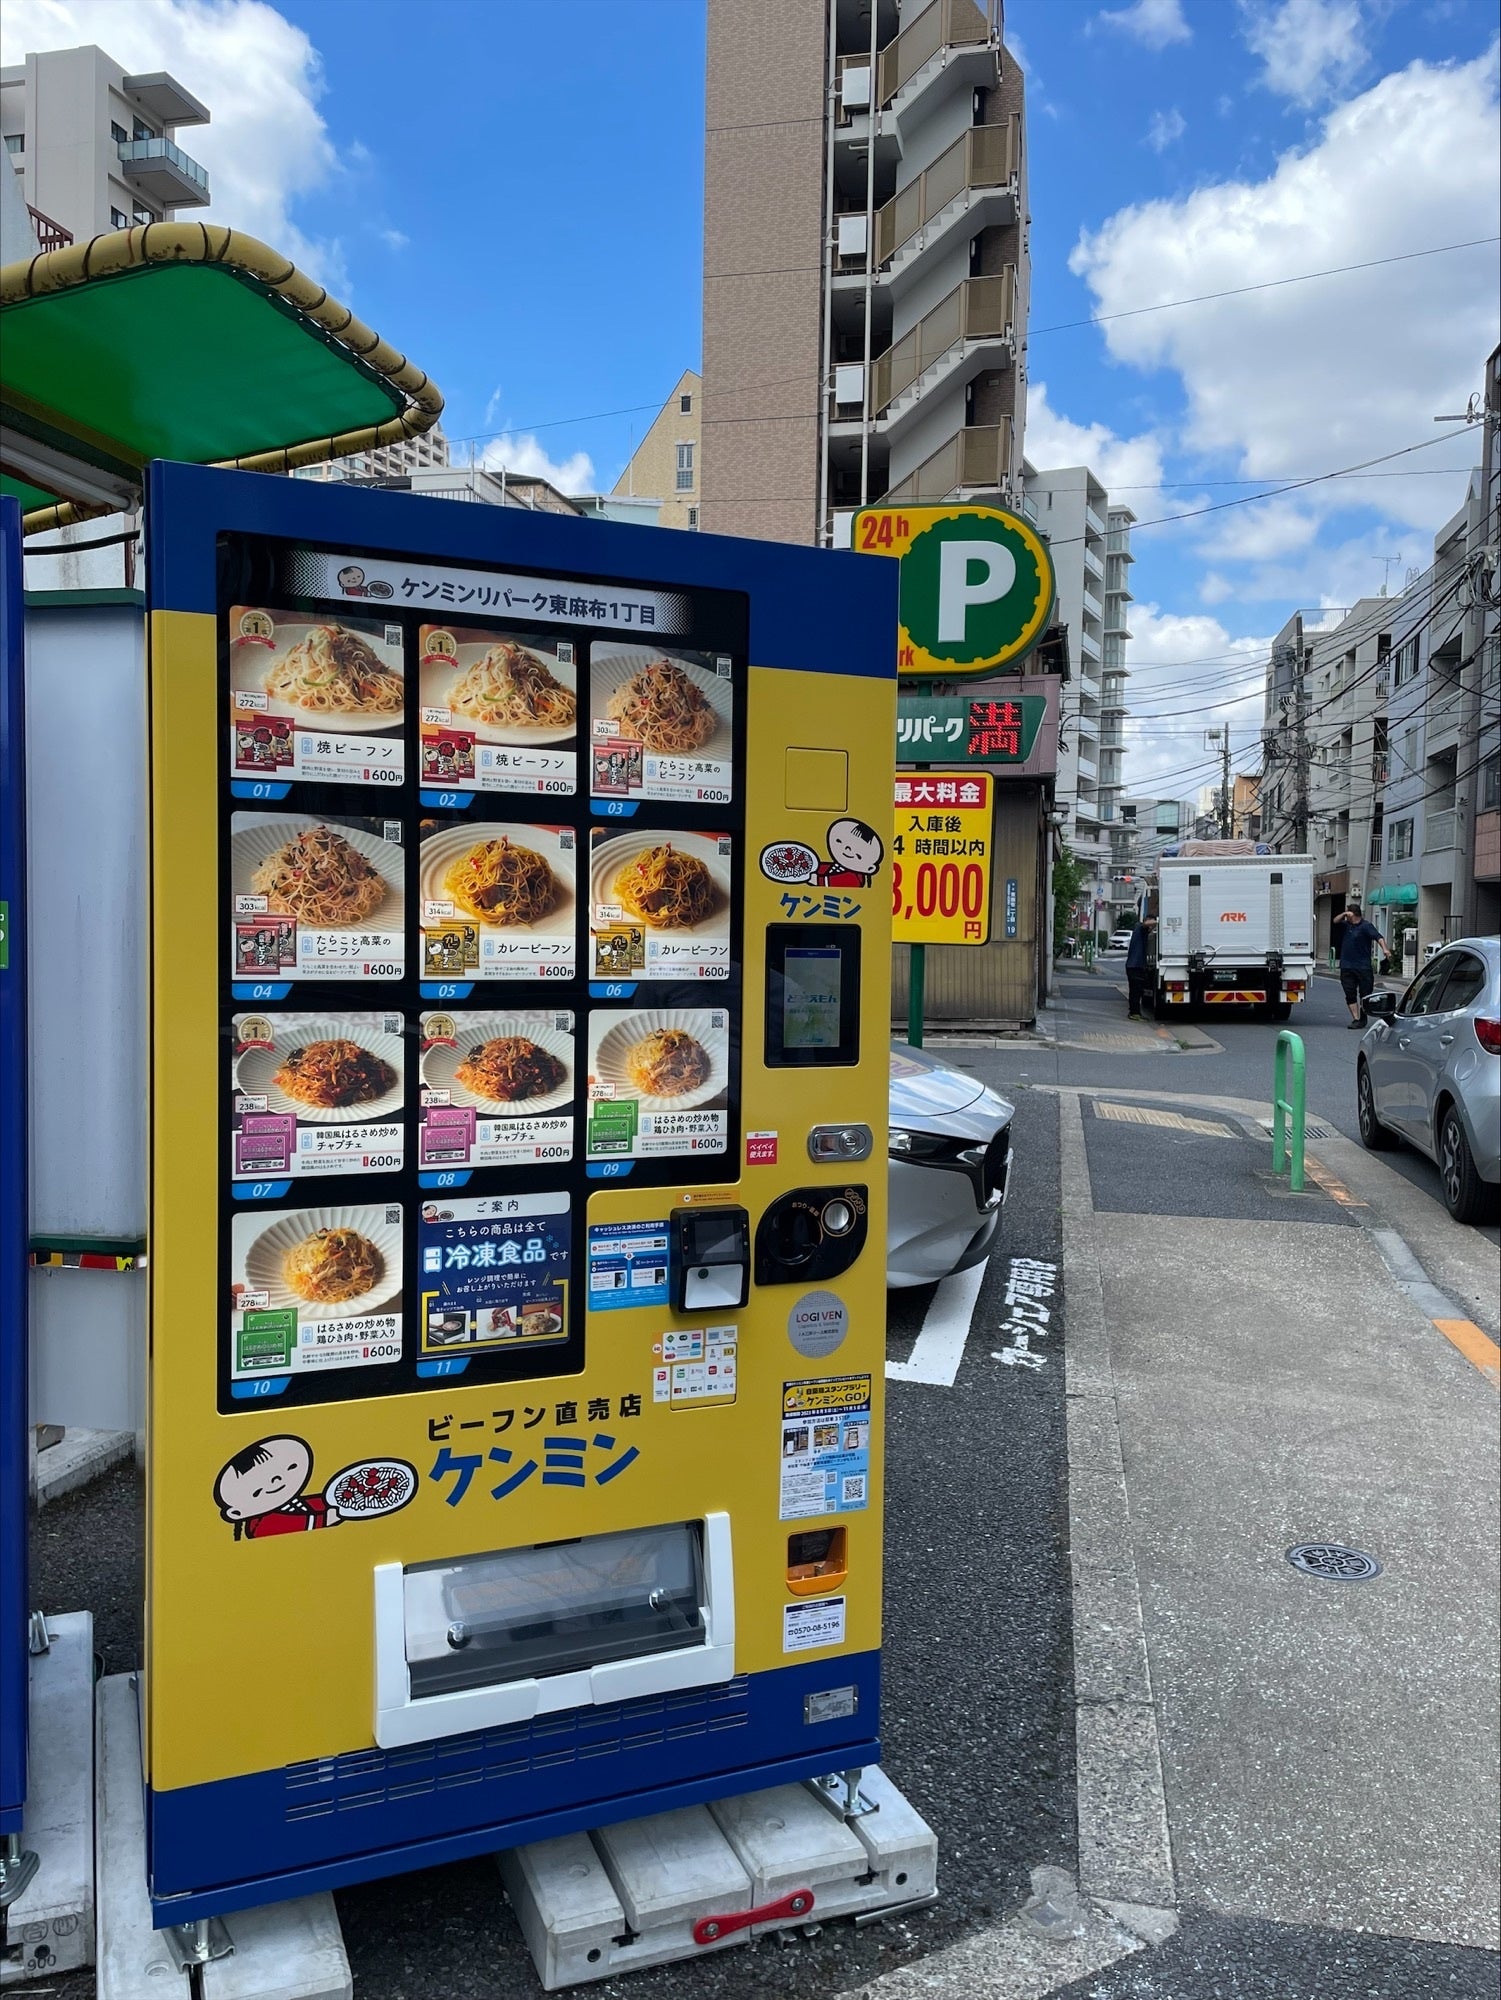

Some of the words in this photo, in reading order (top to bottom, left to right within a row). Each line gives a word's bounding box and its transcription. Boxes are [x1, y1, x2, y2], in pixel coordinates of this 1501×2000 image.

[938, 540, 1017, 643] P
[401, 577, 655, 625] ケンミンリパーク東麻布1丁目
[897, 715, 964, 743] リパーク
[968, 702, 1023, 756] 満
[317, 741, 393, 757] 焼ビーフン
[495, 753, 565, 769] 焼ビーフン
[659, 760, 721, 774] たらこと高菜の
[372, 769, 403, 783] 600円
[659, 772, 696, 781] ビーフン
[253, 784, 271, 798] 01
[545, 781, 574, 793] 600円
[895, 782, 981, 803] 最大料金
[439, 793, 457, 807] 02
[703, 790, 729, 801] 600円
[607, 803, 623, 815] 03
[908, 815, 962, 833] 入庫後
[915, 838, 985, 856] 時間以内
[780, 892, 862, 919] ケンミン
[1220, 912, 1247, 922] ARK
[964, 921, 981, 939] 円
[316, 935, 391, 946] たらこと高菜の
[317, 947, 361, 956] ビーフン
[498, 943, 572, 955] カレービーフン
[661, 946, 728, 956] カレービーフン
[370, 964, 402, 975] 600円
[545, 966, 574, 977] 600円
[253, 985, 273, 998] 04
[438, 985, 456, 997] 05
[606, 984, 622, 996] 06
[494, 1119, 568, 1132] 韓国風はるさめ炒め
[654, 1113, 720, 1125] はるさめの炒め物
[316, 1127, 399, 1140] 韓国風はるさめ炒め
[653, 1124, 719, 1135] 鶏ひき肉・野菜入り
[494, 1132, 536, 1142] チャプチェ
[317, 1141, 363, 1151] チャプチェ
[697, 1138, 723, 1150] 600円
[541, 1147, 570, 1158] 600円
[369, 1155, 401, 1168] 600円
[603, 1163, 619, 1176] 09
[437, 1174, 455, 1186] 08
[252, 1183, 273, 1197] 07
[476, 1200, 519, 1213] ご案内
[445, 1221, 546, 1238] こちらの商品は全て
[445, 1238, 546, 1270] 冷凍食品
[549, 1250, 569, 1261] です
[317, 1317, 396, 1333] はるさめの炒め物
[316, 1329, 396, 1345] 鶏ひき肉・野菜入り
[370, 1345, 401, 1358] 600円
[436, 1361, 451, 1374] 11
[252, 1381, 271, 1395] 10
[427, 1394, 642, 1441] ビーフン直売店
[428, 1433, 640, 1507] ケンミン
[27, 1954, 57, 1971] 900
